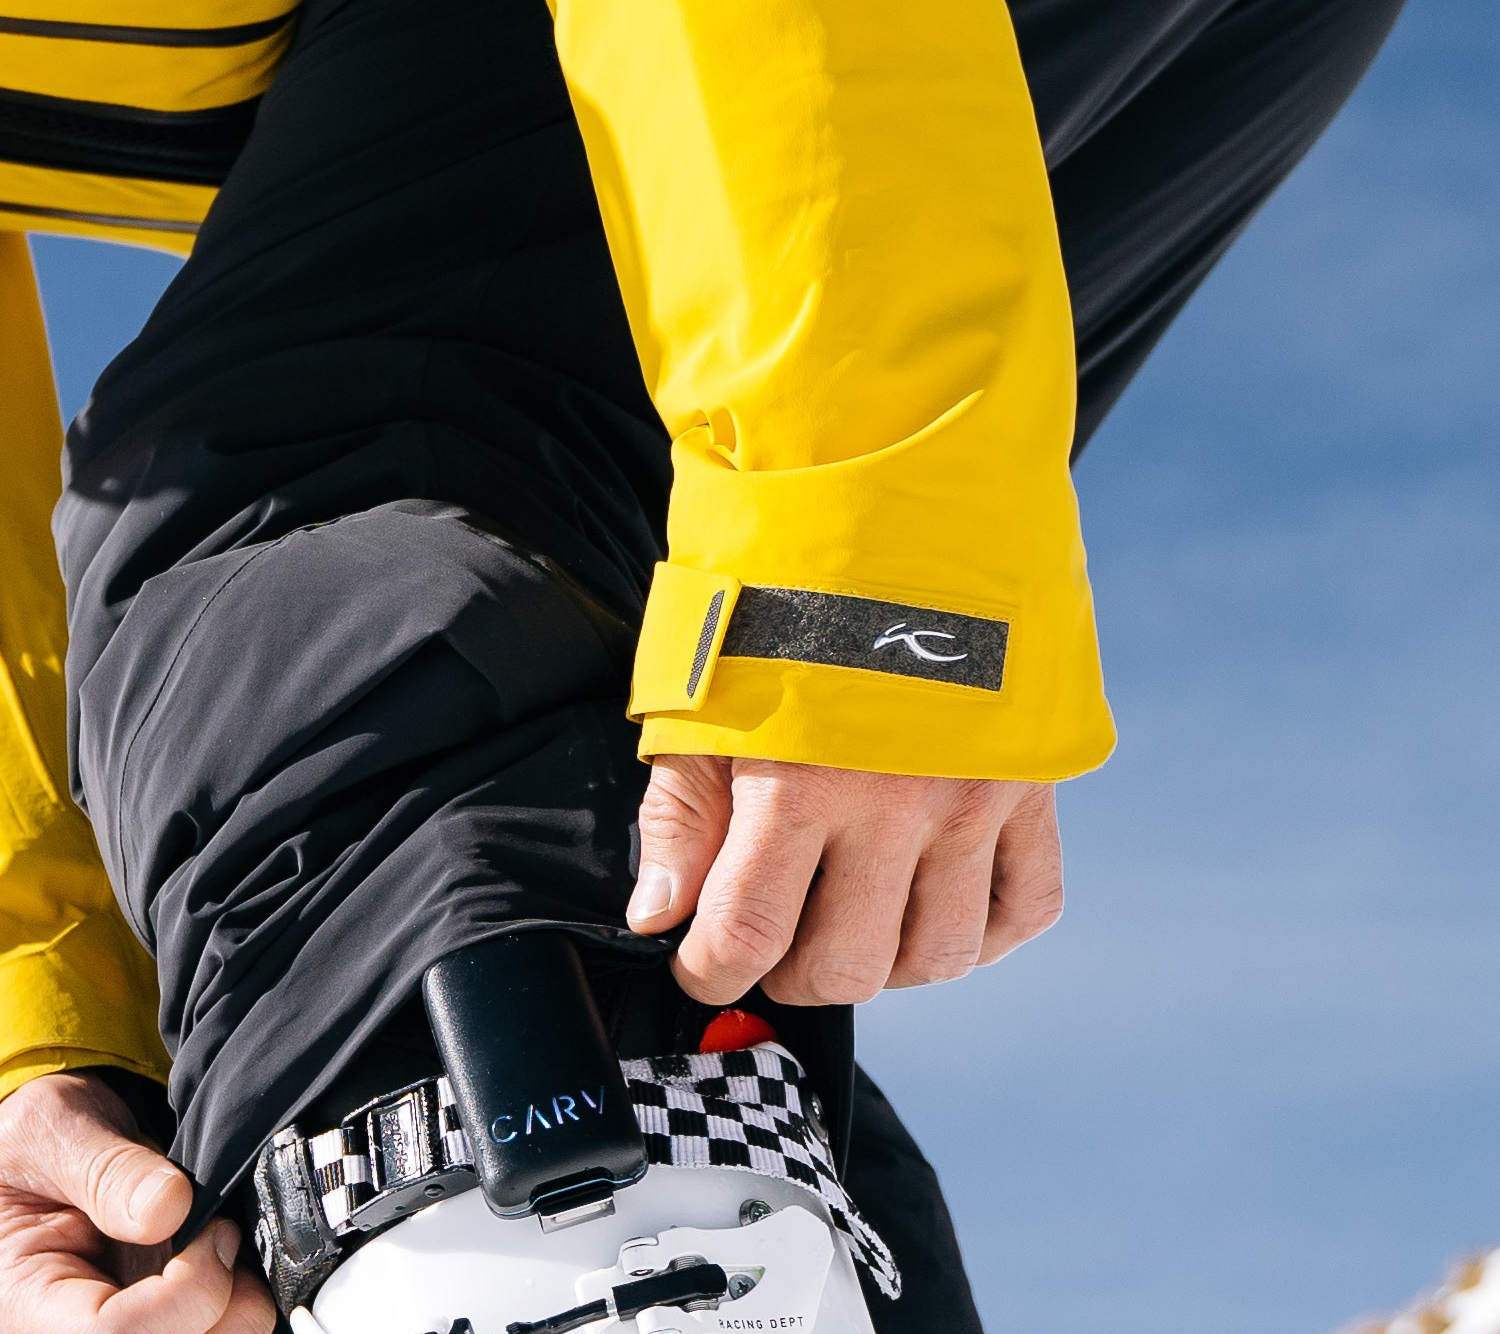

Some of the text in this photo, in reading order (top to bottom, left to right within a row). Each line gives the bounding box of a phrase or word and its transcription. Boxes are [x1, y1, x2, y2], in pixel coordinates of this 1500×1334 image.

[490, 1085, 605, 1144] CARV
[718, 1316, 804, 1330] RACING DEPT
